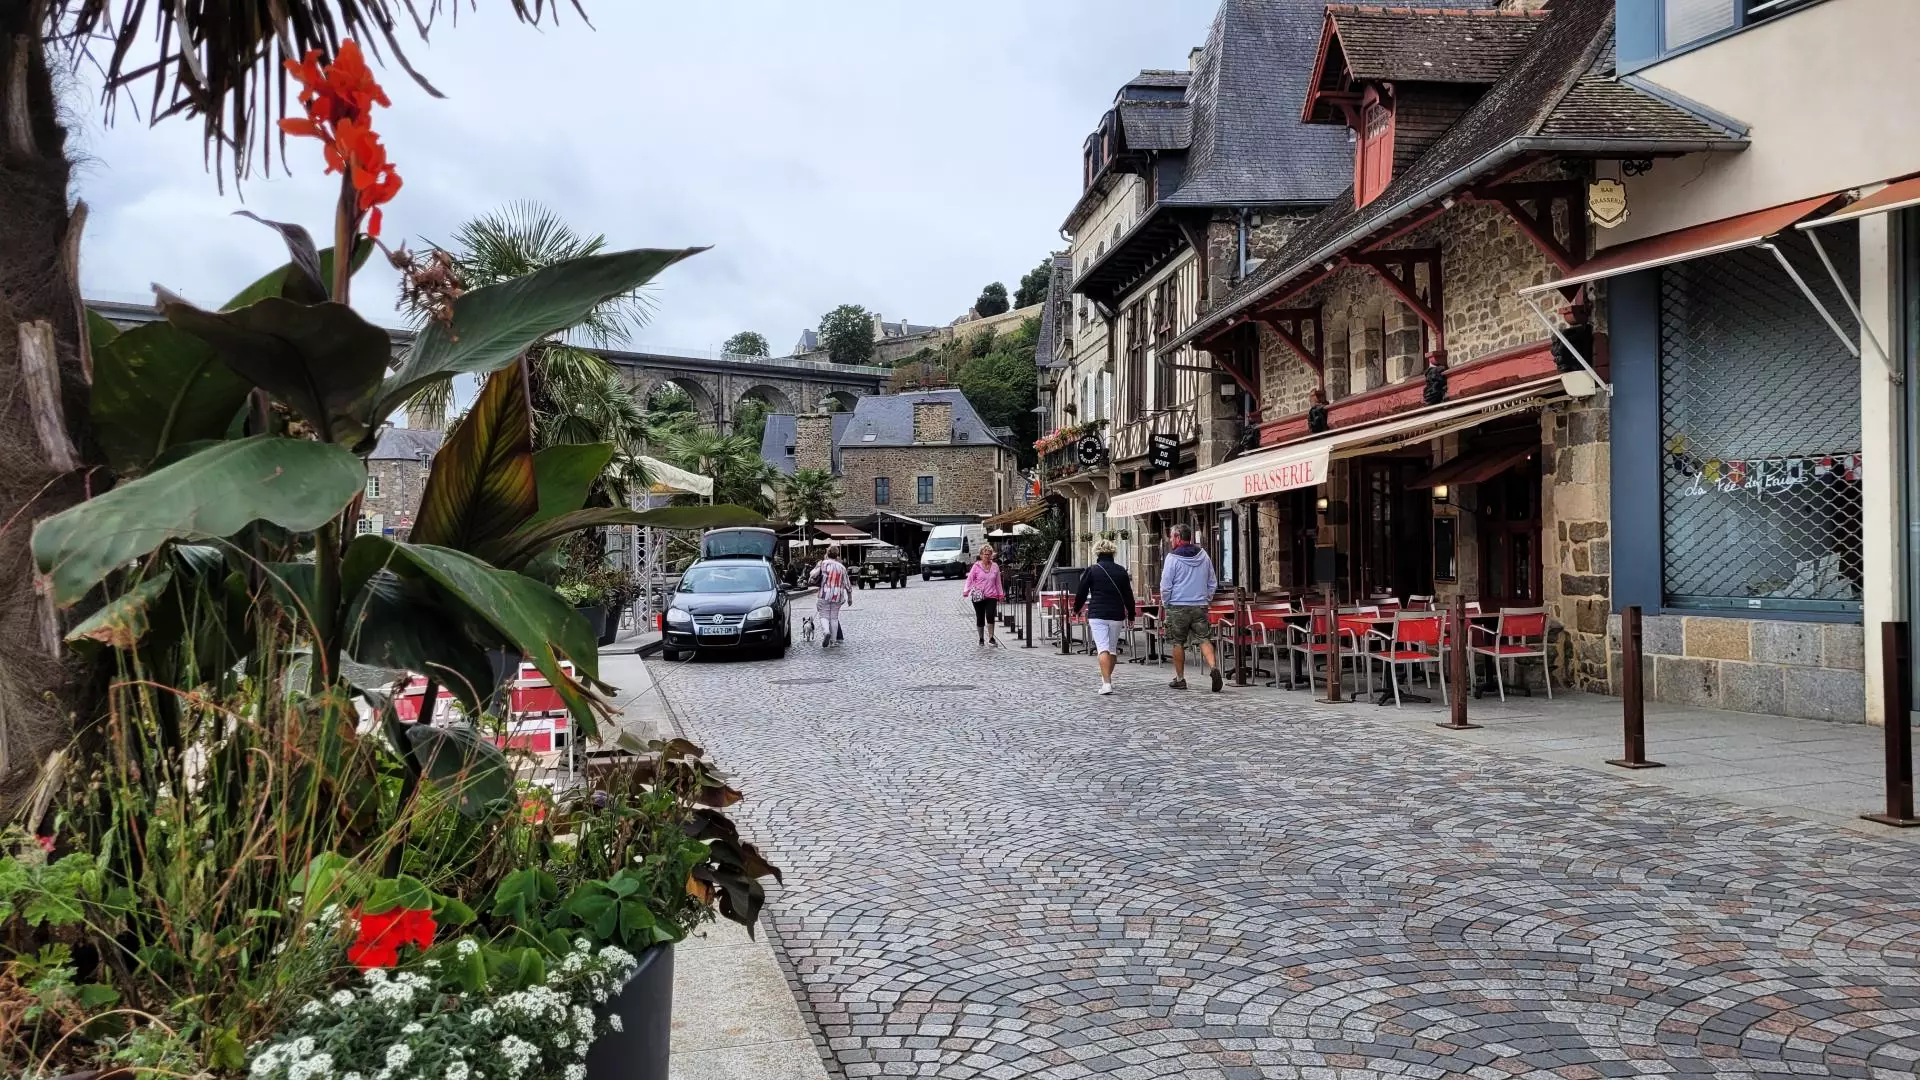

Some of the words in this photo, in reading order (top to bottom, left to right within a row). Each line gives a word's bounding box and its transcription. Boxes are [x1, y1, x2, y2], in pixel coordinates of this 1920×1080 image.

[1154, 435, 1177, 447] BUREAU
[1160, 450, 1169, 458] DU
[1154, 458, 1171, 468] PORT
[1244, 461, 1315, 494] BRASSERIE
[1684, 471, 1708, 497] La
[1183, 487, 1194, 504] TY
[1195, 483, 1215, 502] COZ
[1116, 501, 1129, 516] BAR
